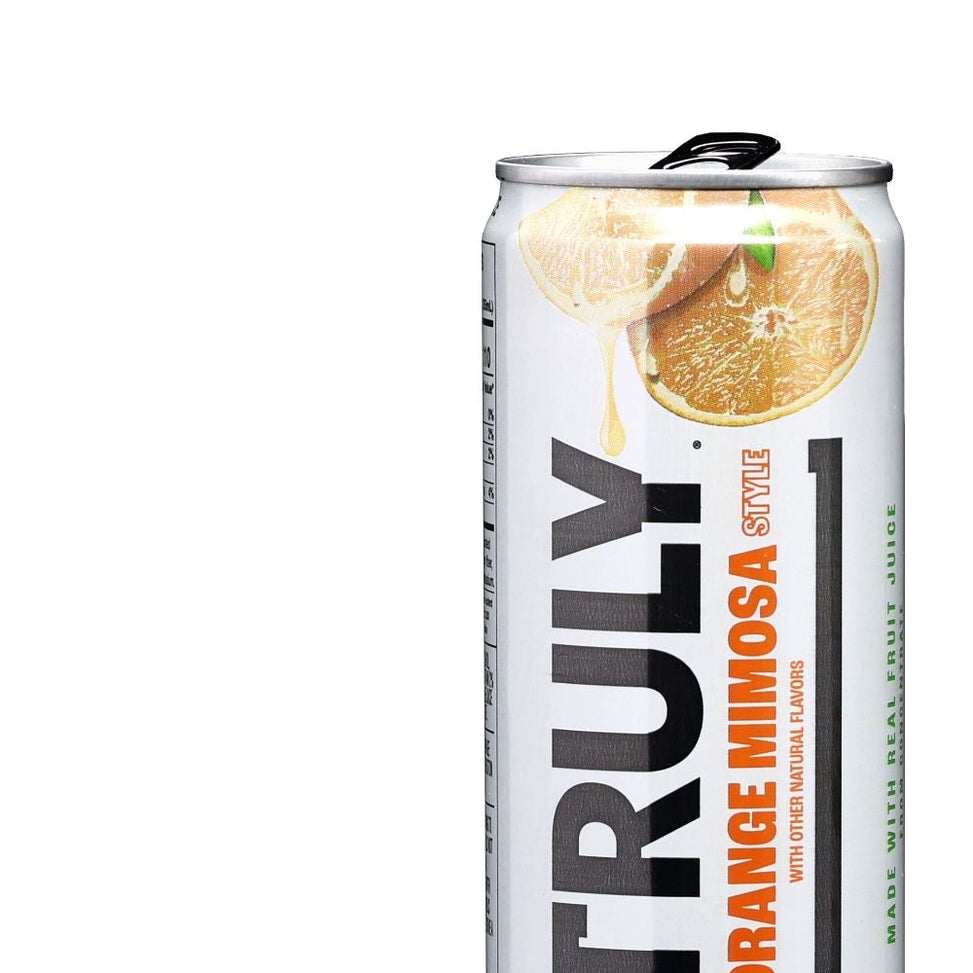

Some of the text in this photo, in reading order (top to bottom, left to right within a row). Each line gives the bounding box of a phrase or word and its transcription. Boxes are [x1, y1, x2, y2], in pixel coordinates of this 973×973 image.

[741, 448, 770, 537] STYLE
[728, 545, 777, 769] MIMOSA
[887, 503, 896, 944] MADE WITH REAL FRUIT JUICE
[789, 660, 804, 883] WITH OTHER NATURAL FLAVORS
